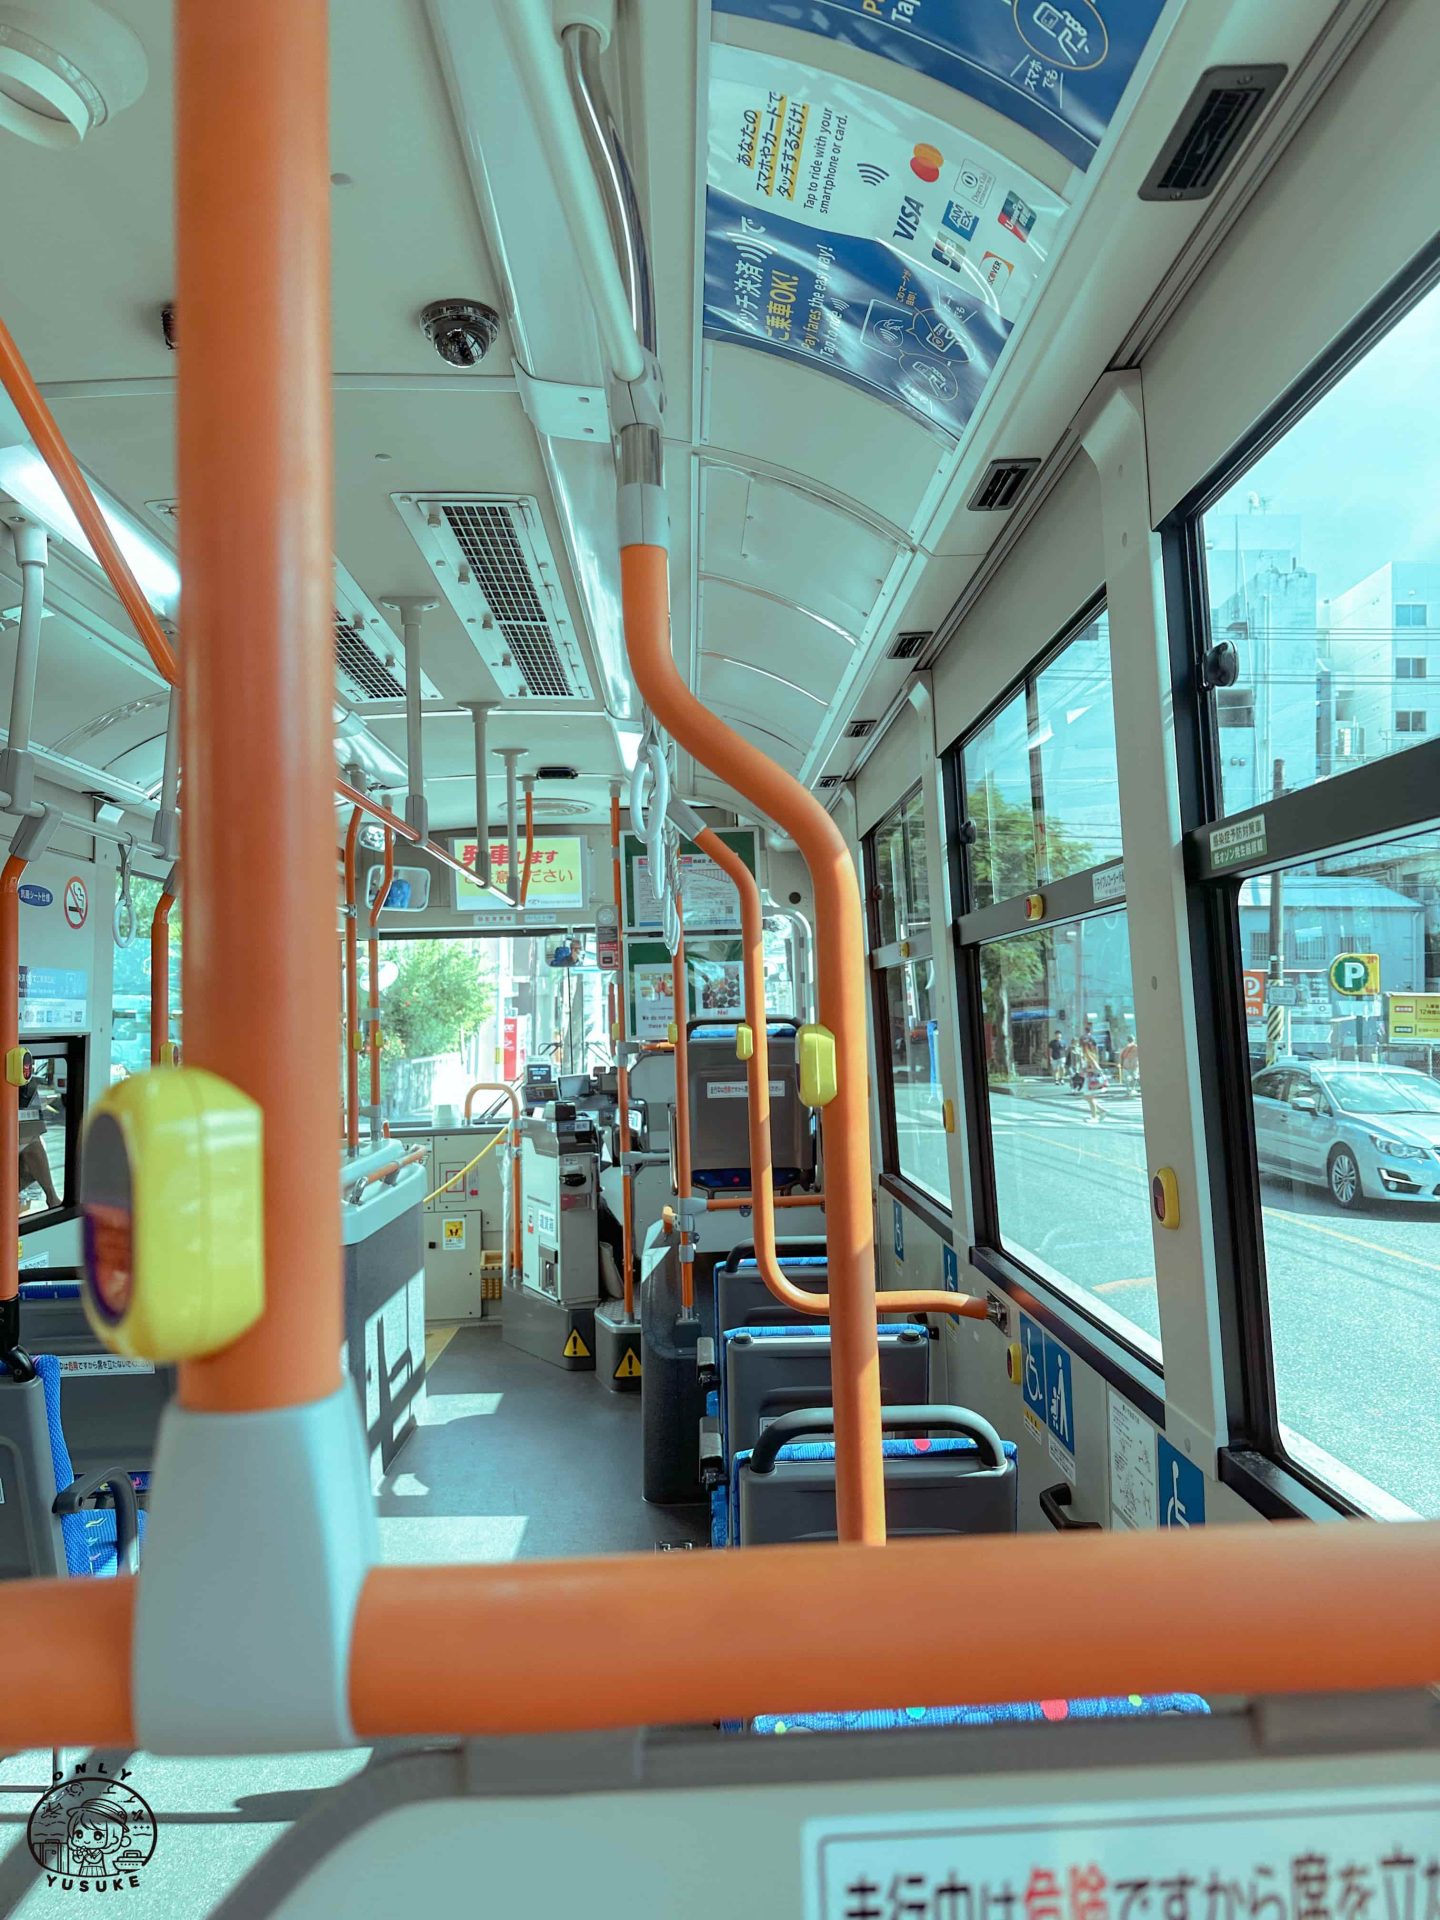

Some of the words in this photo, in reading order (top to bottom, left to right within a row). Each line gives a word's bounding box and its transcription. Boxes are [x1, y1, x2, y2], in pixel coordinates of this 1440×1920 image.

[863, 0, 885, 16] P
[1024, 59, 1043, 92] スマホ
[1042, 69, 1058, 89] でも
[821, 107, 834, 135] your
[834, 114, 849, 142] card.
[736, 109, 759, 168] あなたの
[756, 90, 785, 197] スマホやカードで
[776, 101, 807, 198] タッチするだけ!
[814, 135, 828, 158] with
[832, 141, 843, 154] or
[809, 160, 823, 180] ride
[808, 179, 819, 192] to
[819, 155, 840, 215] smartphone
[803, 190, 818, 210] Tap
[892, 194, 925, 241] VISA
[950, 203, 963, 225] AM
[960, 210, 974, 231] EX
[765, 269, 800, 341] ご乗車OK!
[807, 290, 825, 308] the
[803, 307, 822, 332] fares
[801, 332, 820, 350] Pay
[1344, 962, 1365, 988] P
